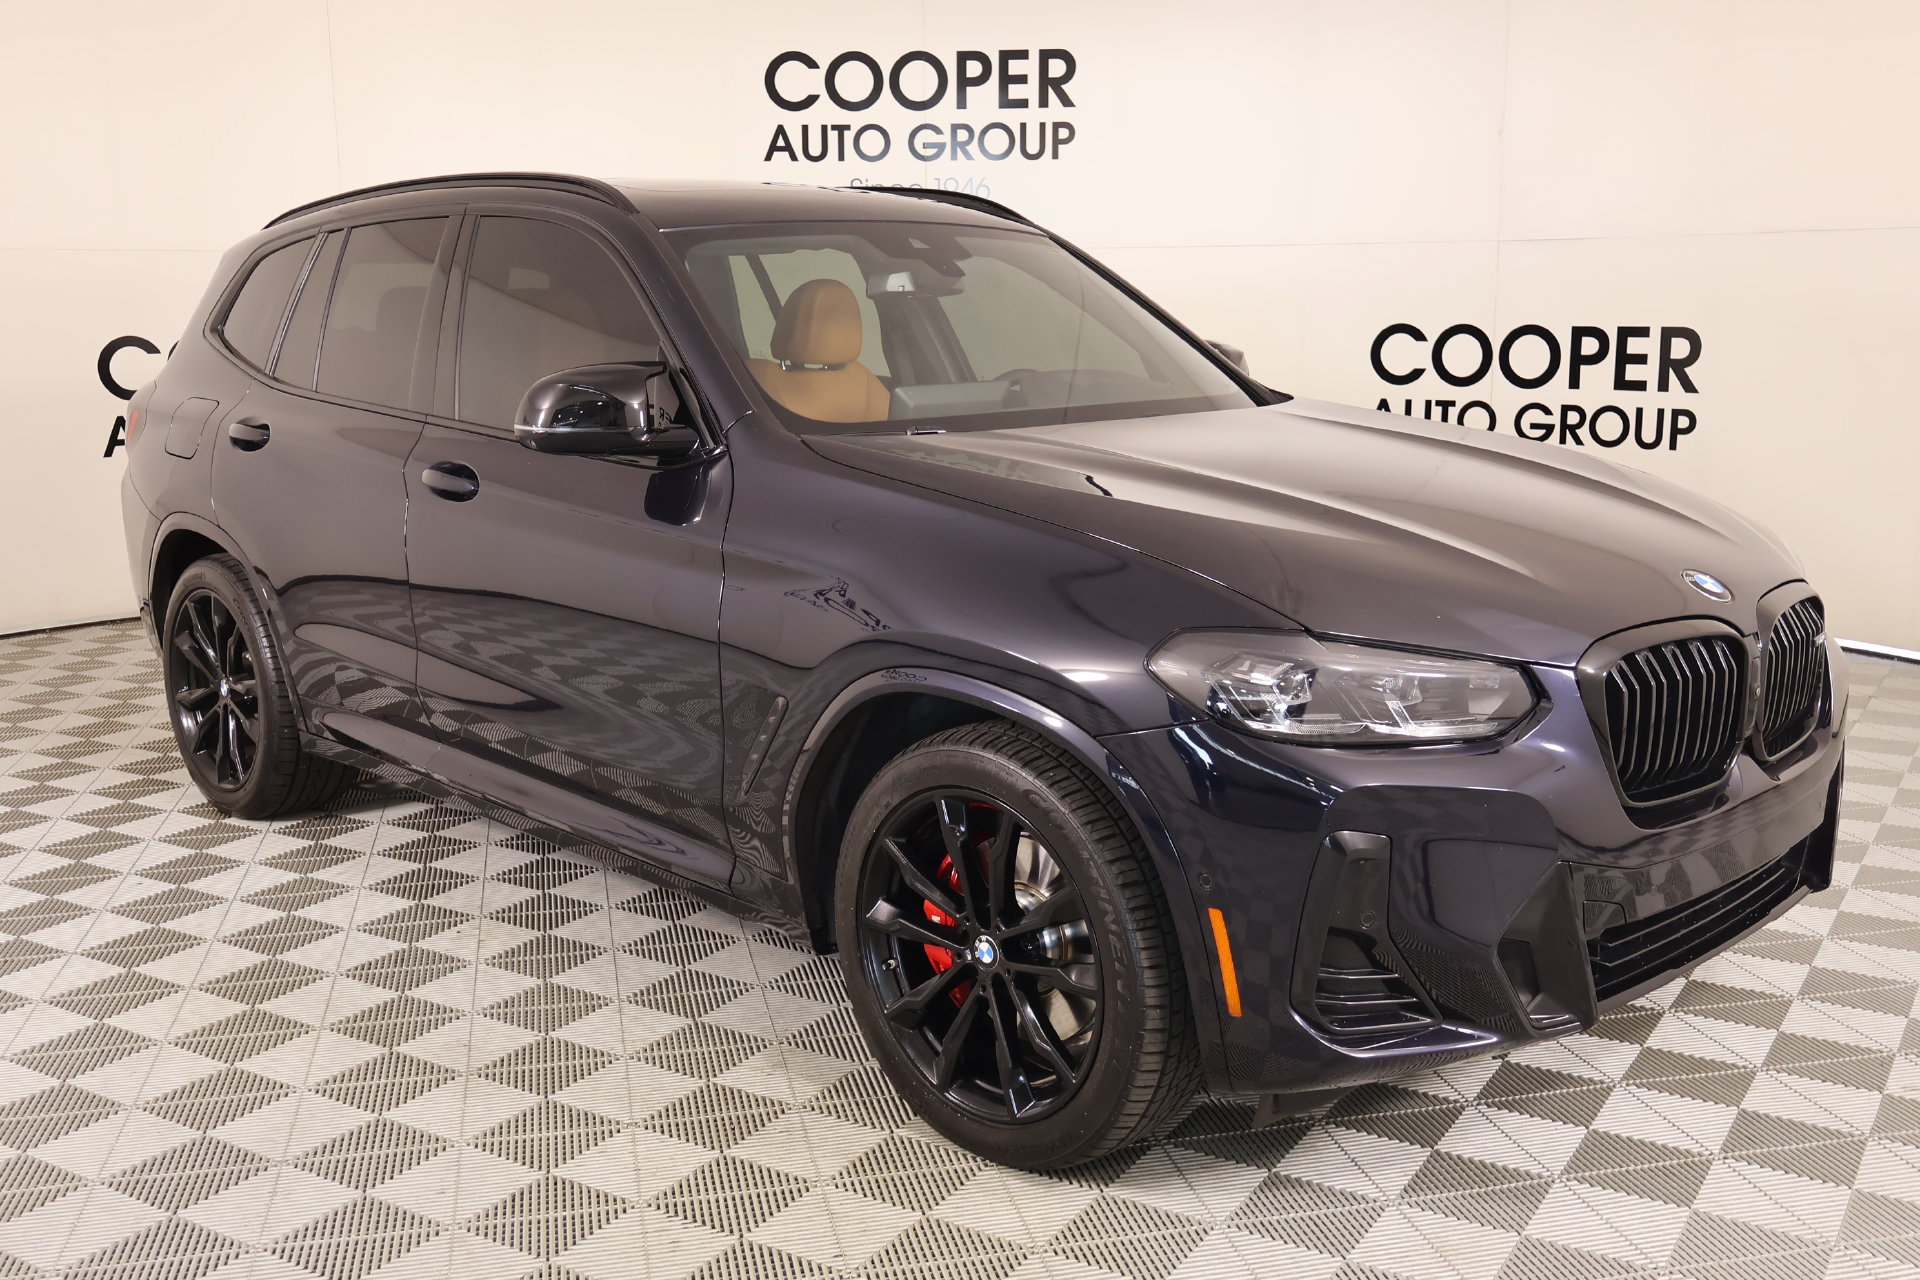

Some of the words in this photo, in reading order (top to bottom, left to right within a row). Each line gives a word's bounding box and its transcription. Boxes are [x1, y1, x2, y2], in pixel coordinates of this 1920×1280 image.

[764, 48, 1077, 112] COOPER
[763, 123, 891, 163] AUTO
[907, 121, 1076, 163] GROUP
[1370, 322, 1702, 393] COOPER
[1514, 402, 1697, 451] GROUP
